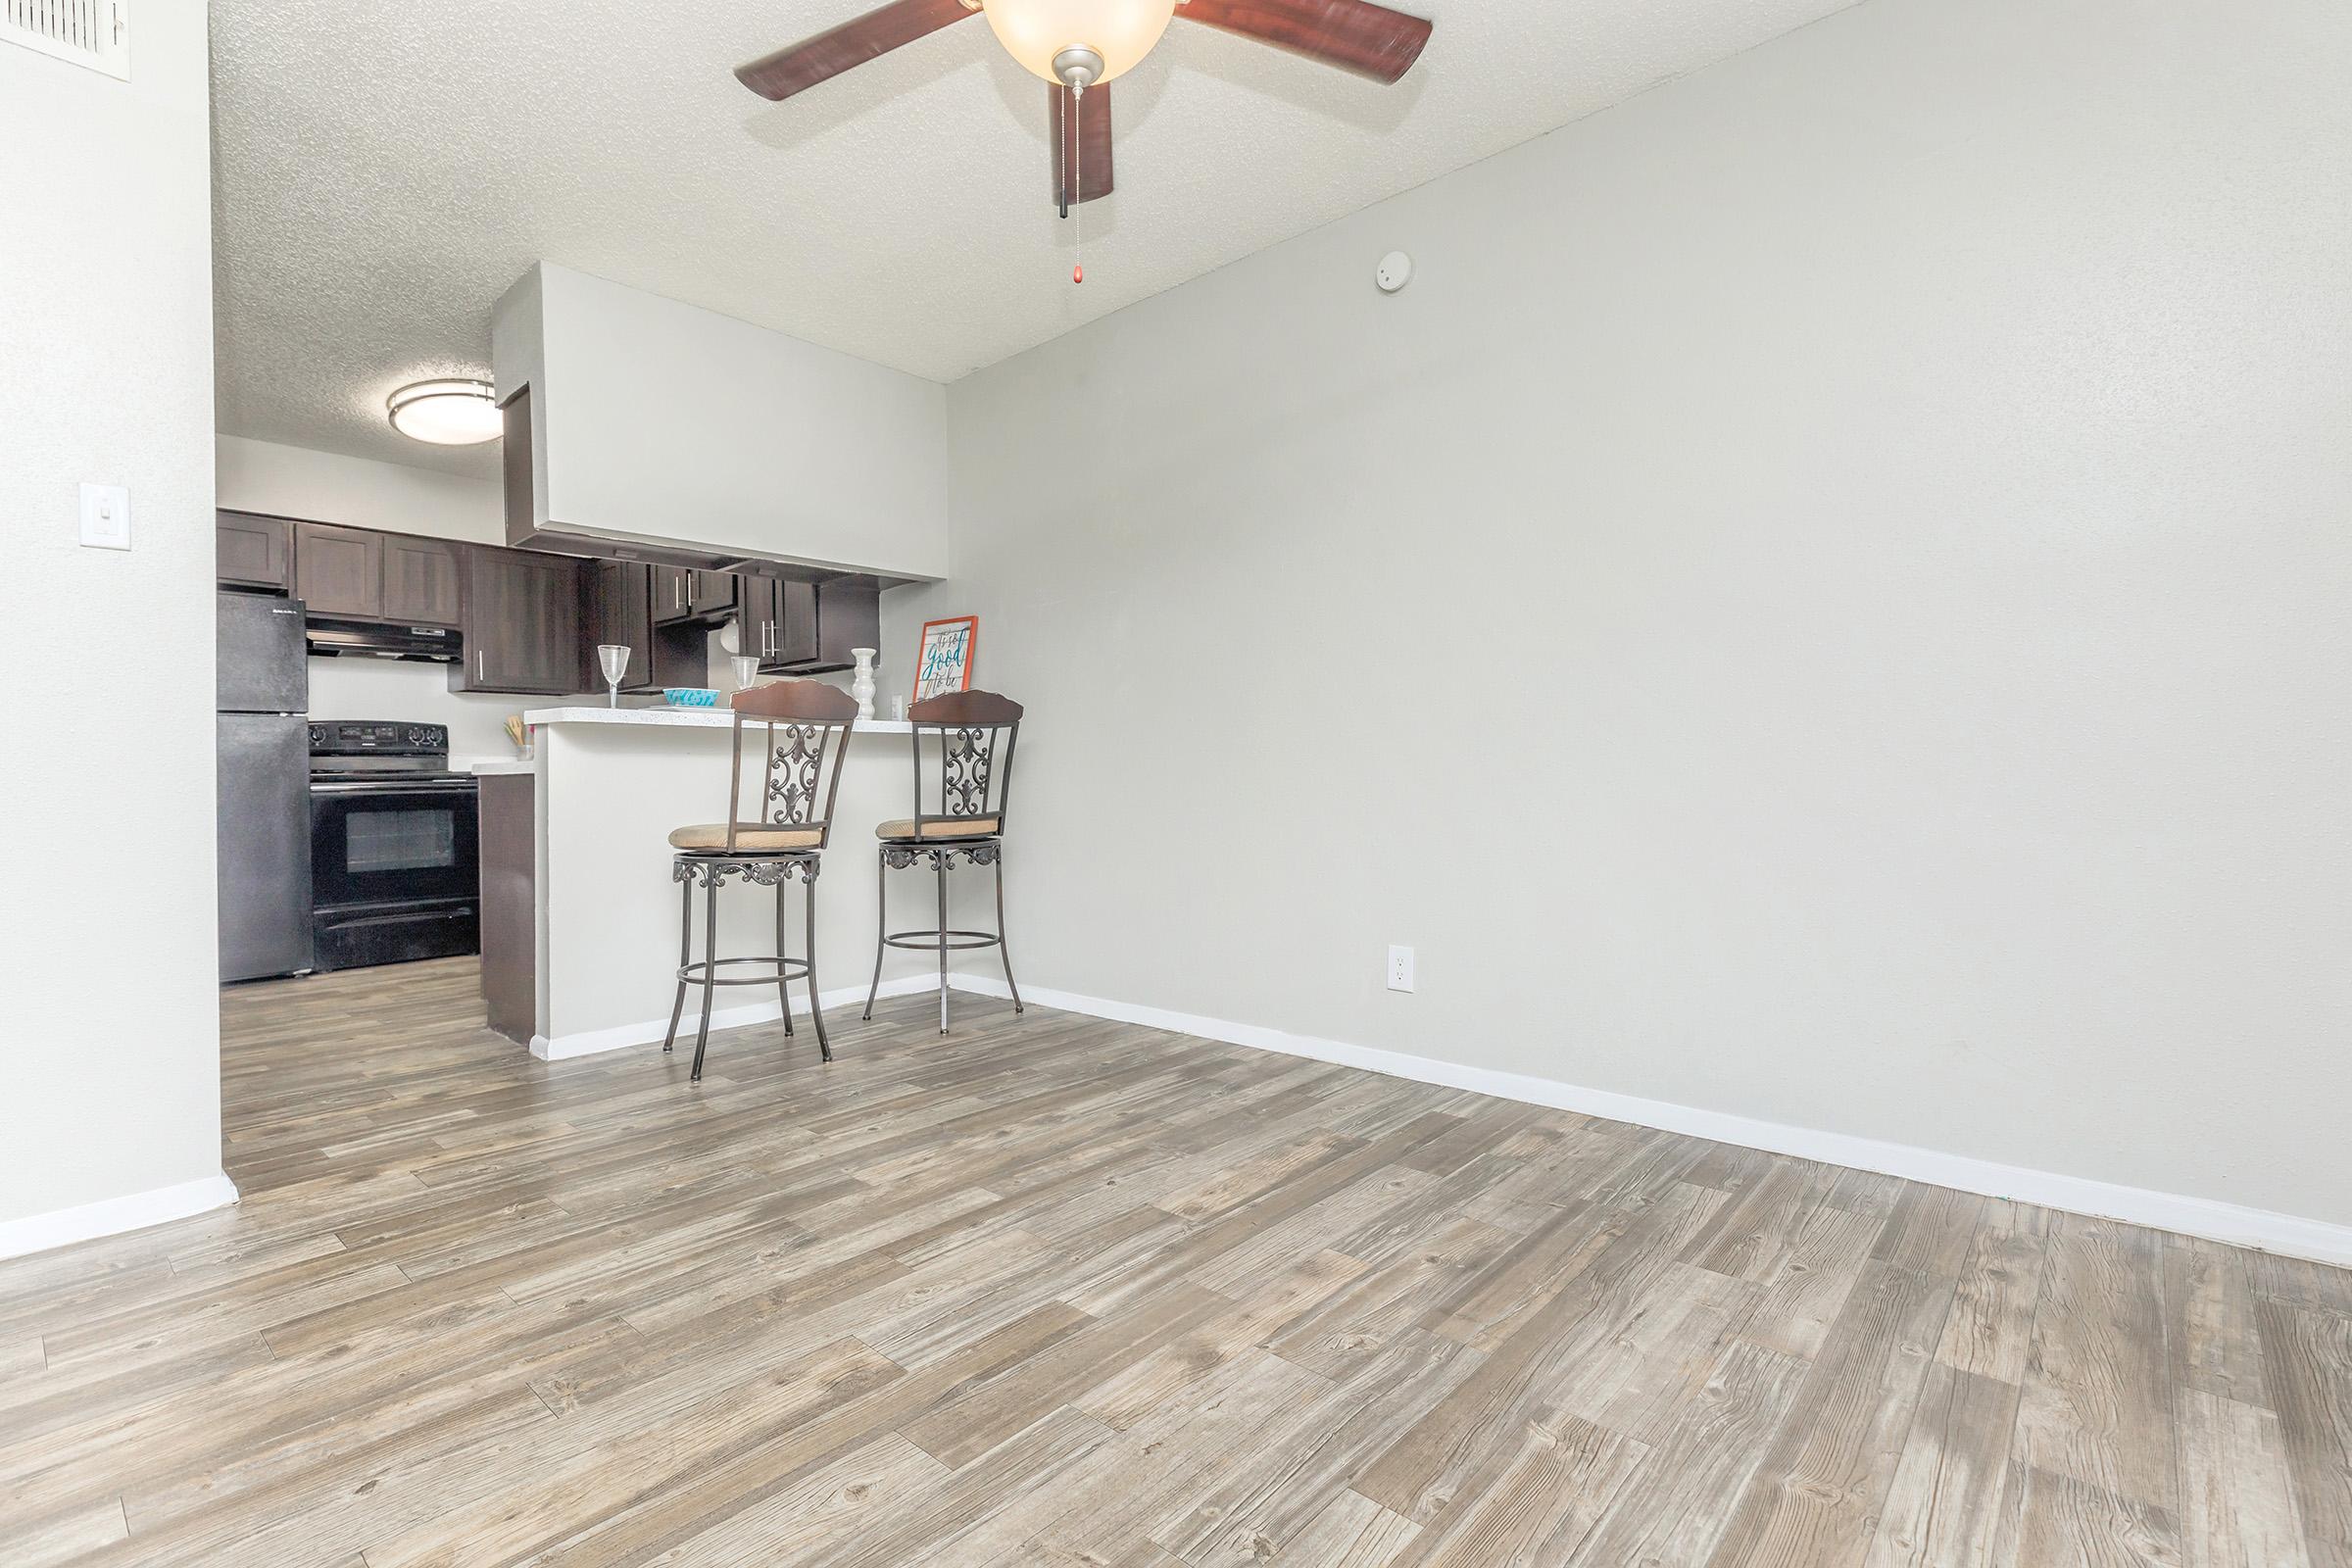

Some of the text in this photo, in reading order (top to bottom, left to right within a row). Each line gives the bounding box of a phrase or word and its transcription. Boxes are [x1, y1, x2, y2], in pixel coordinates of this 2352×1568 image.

[922, 627, 969, 681] good
[932, 672, 946, 694] to
[946, 663, 956, 687] be
